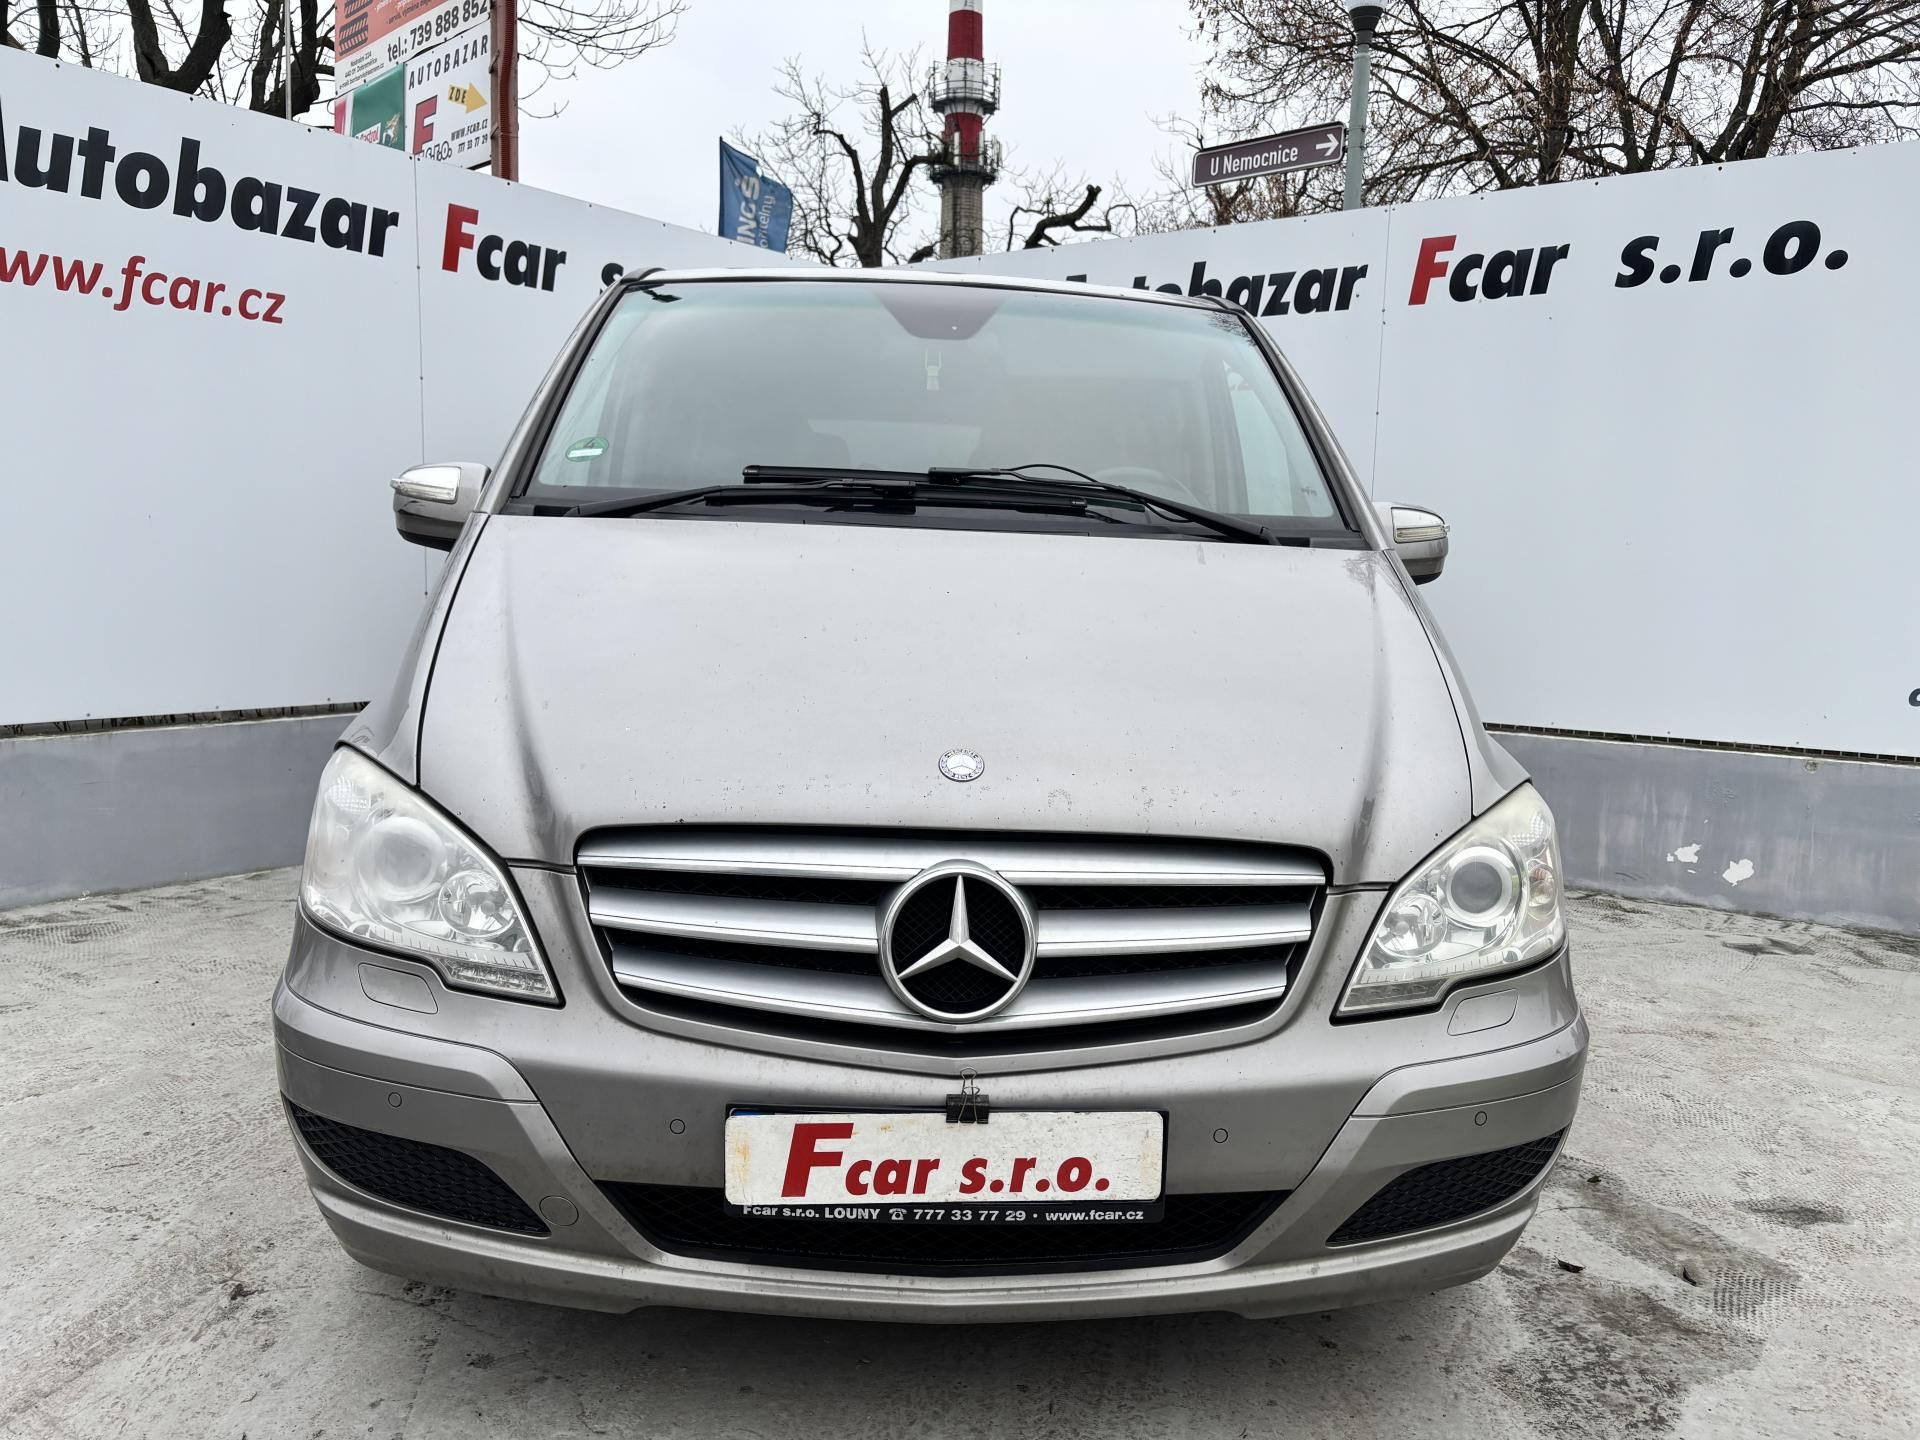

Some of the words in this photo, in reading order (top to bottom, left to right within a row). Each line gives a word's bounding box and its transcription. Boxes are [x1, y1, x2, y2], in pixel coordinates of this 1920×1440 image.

[388, 36, 407, 62] tel.:
[410, 21, 432, 50] 739
[435, 6, 459, 36] 888
[462, 0, 488, 22] 852
[408, 34, 488, 90] AUTOBAZAR
[449, 86, 467, 104] ZDE
[0, 101, 400, 258] utobazar
[1210, 156, 1219, 177] U
[1222, 144, 1299, 175] Nemocnice
[441, 202, 567, 293] Fcar
[1408, 234, 1571, 306] Fcar
[1614, 220, 1849, 289] s.r.o.
[780, 1122, 940, 1198] Fcar
[959, 1156, 1110, 1194] s.r.o.
[743, 1205, 778, 1216] Fcar
[782, 1206, 820, 1218] s.r.o.
[824, 1207, 881, 1220] LOUNY
[913, 1209, 945, 1220] 777
[950, 1210, 973, 1221] 33
[978, 1210, 1000, 1221] 77
[1005, 1210, 1026, 1221] 29
[1045, 1209, 1144, 1221] www.fcar.cz
